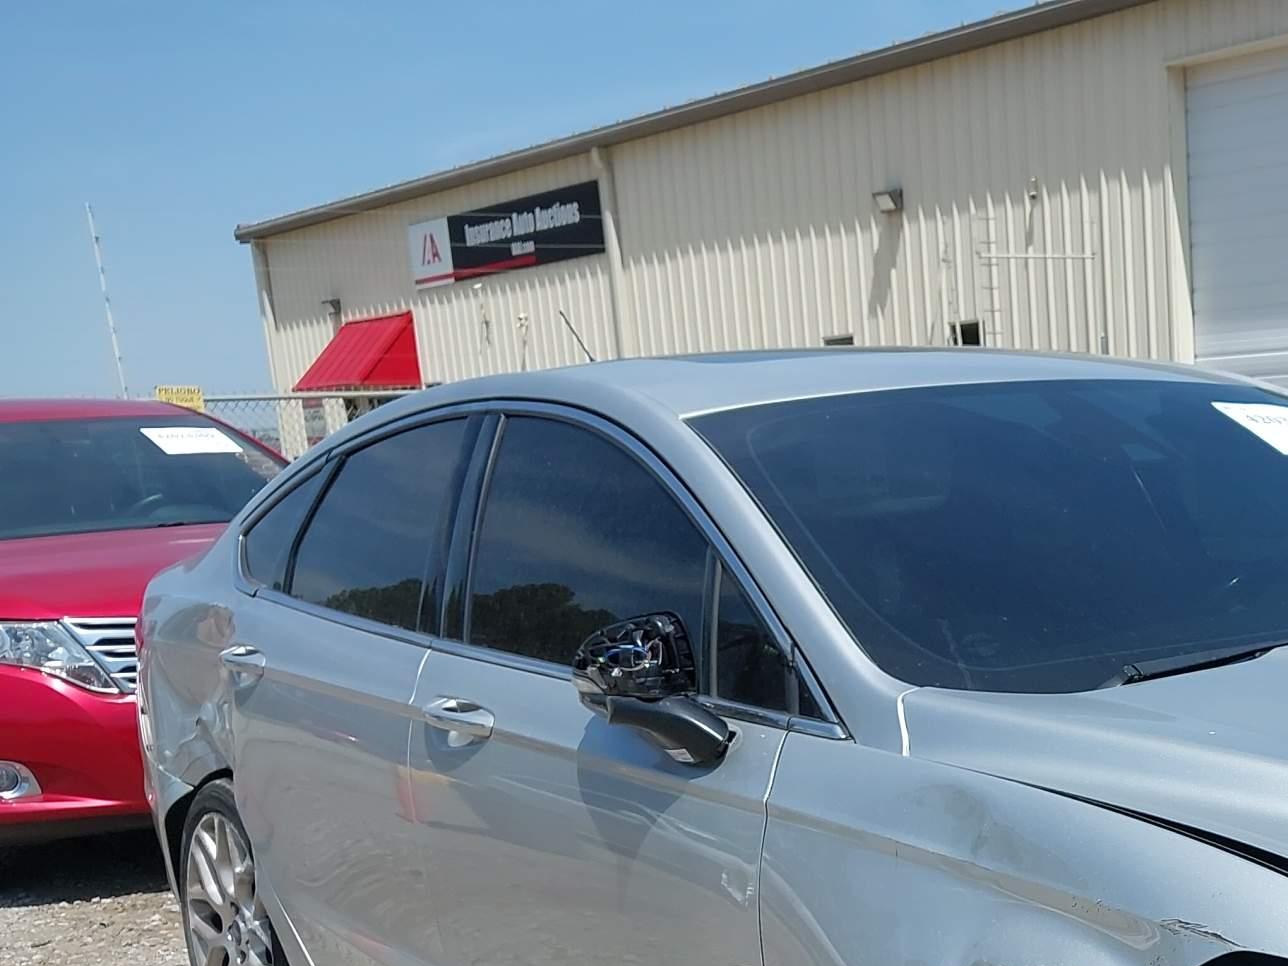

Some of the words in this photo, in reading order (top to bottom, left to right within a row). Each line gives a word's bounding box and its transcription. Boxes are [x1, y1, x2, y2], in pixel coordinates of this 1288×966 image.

[464, 217, 512, 246] Insurance
[511, 211, 535, 236] Auto
[534, 201, 580, 232] Auctions
